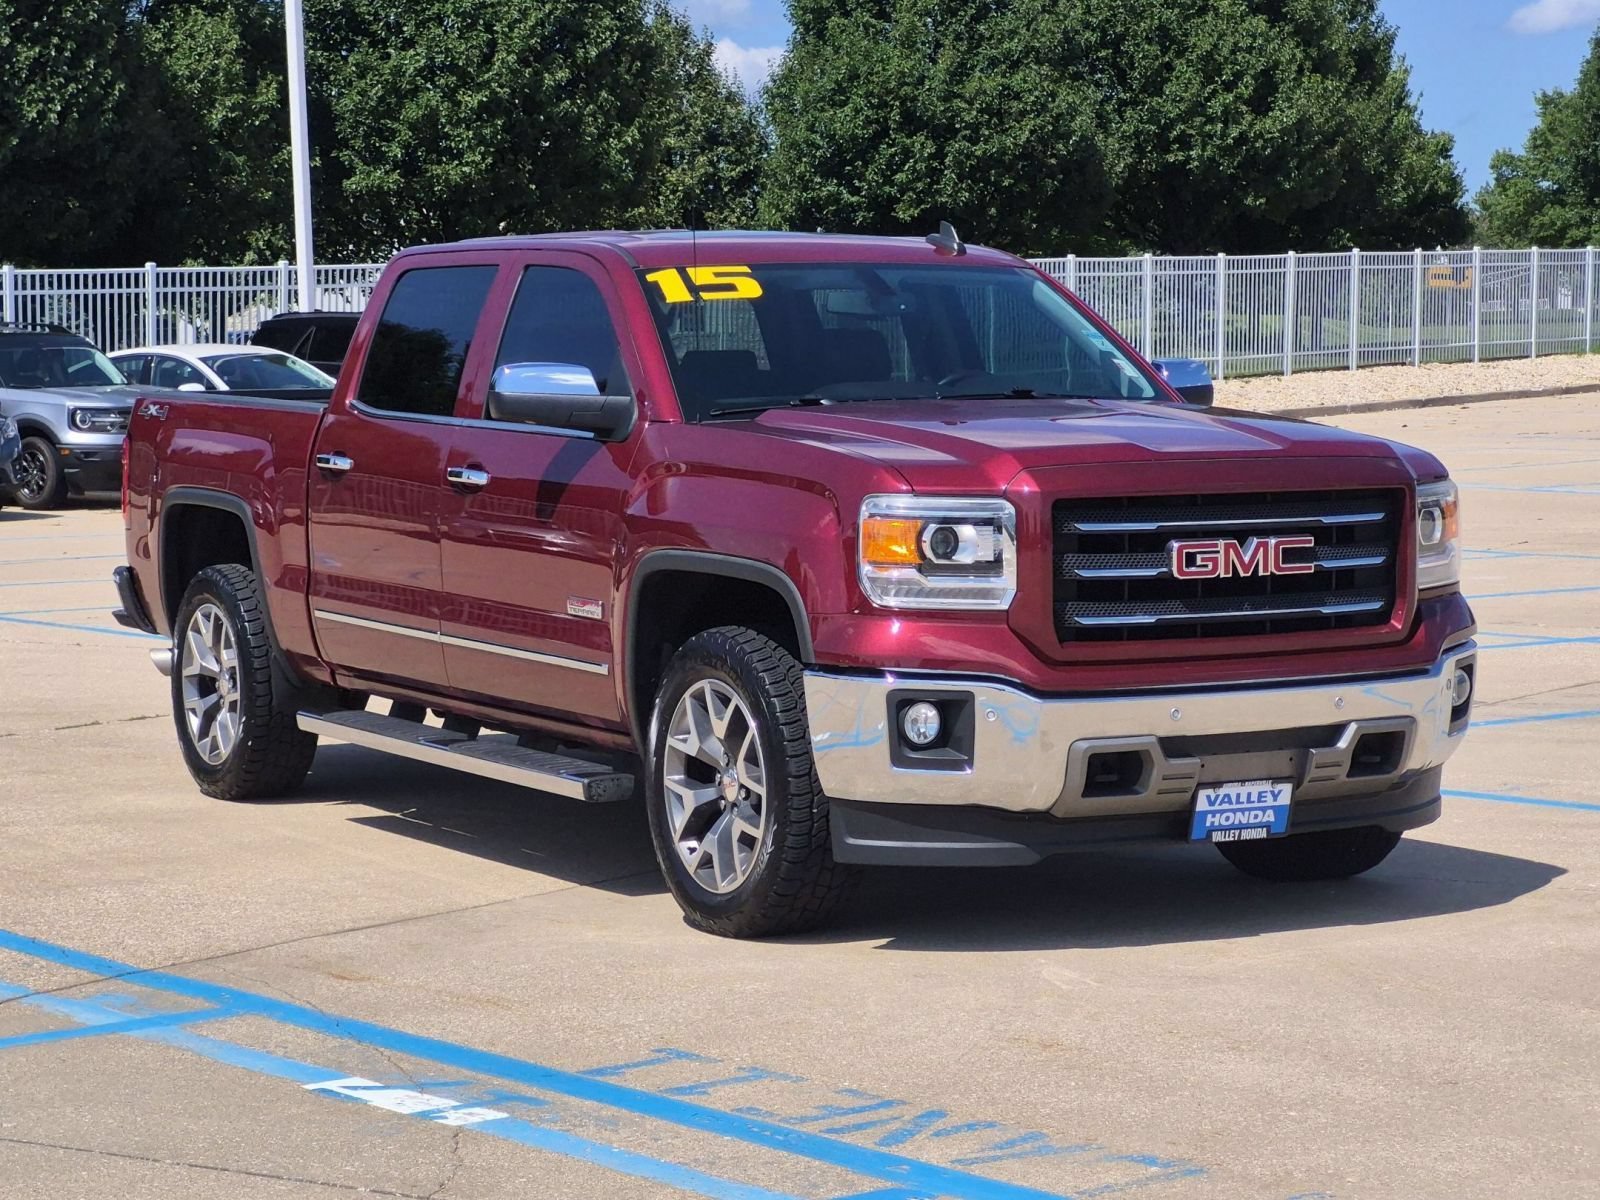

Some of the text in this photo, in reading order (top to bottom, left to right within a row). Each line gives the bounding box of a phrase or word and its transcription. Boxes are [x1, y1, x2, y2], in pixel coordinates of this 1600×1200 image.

[645, 265, 763, 303] 15
[1169, 535, 1315, 580] GMC
[1205, 789, 1283, 807] VALLEY
[1205, 809, 1275, 827] HONDA
[1212, 827, 1267, 842] VALLEY HONDA
